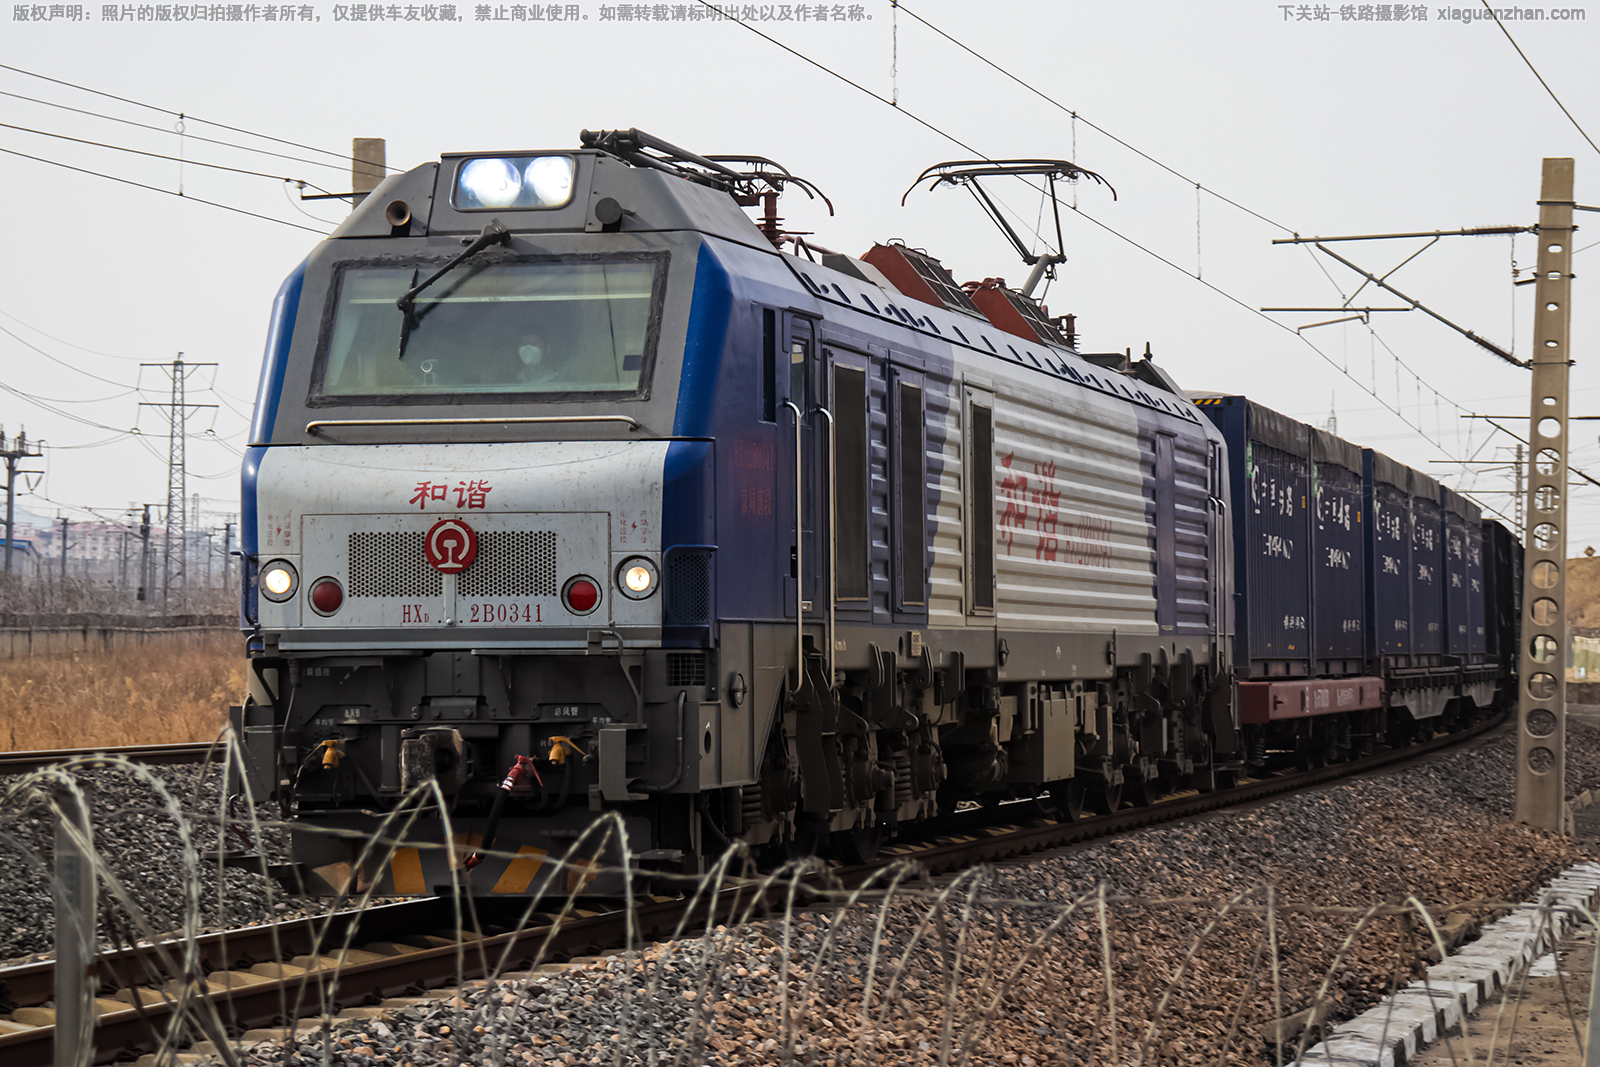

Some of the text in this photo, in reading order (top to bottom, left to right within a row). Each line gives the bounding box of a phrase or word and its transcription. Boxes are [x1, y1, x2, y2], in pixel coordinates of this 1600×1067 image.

[409, 479, 493, 510] 和谐
[402, 603, 543, 623] HXD 2B0341
[554, 706, 579, 717] 总风管
